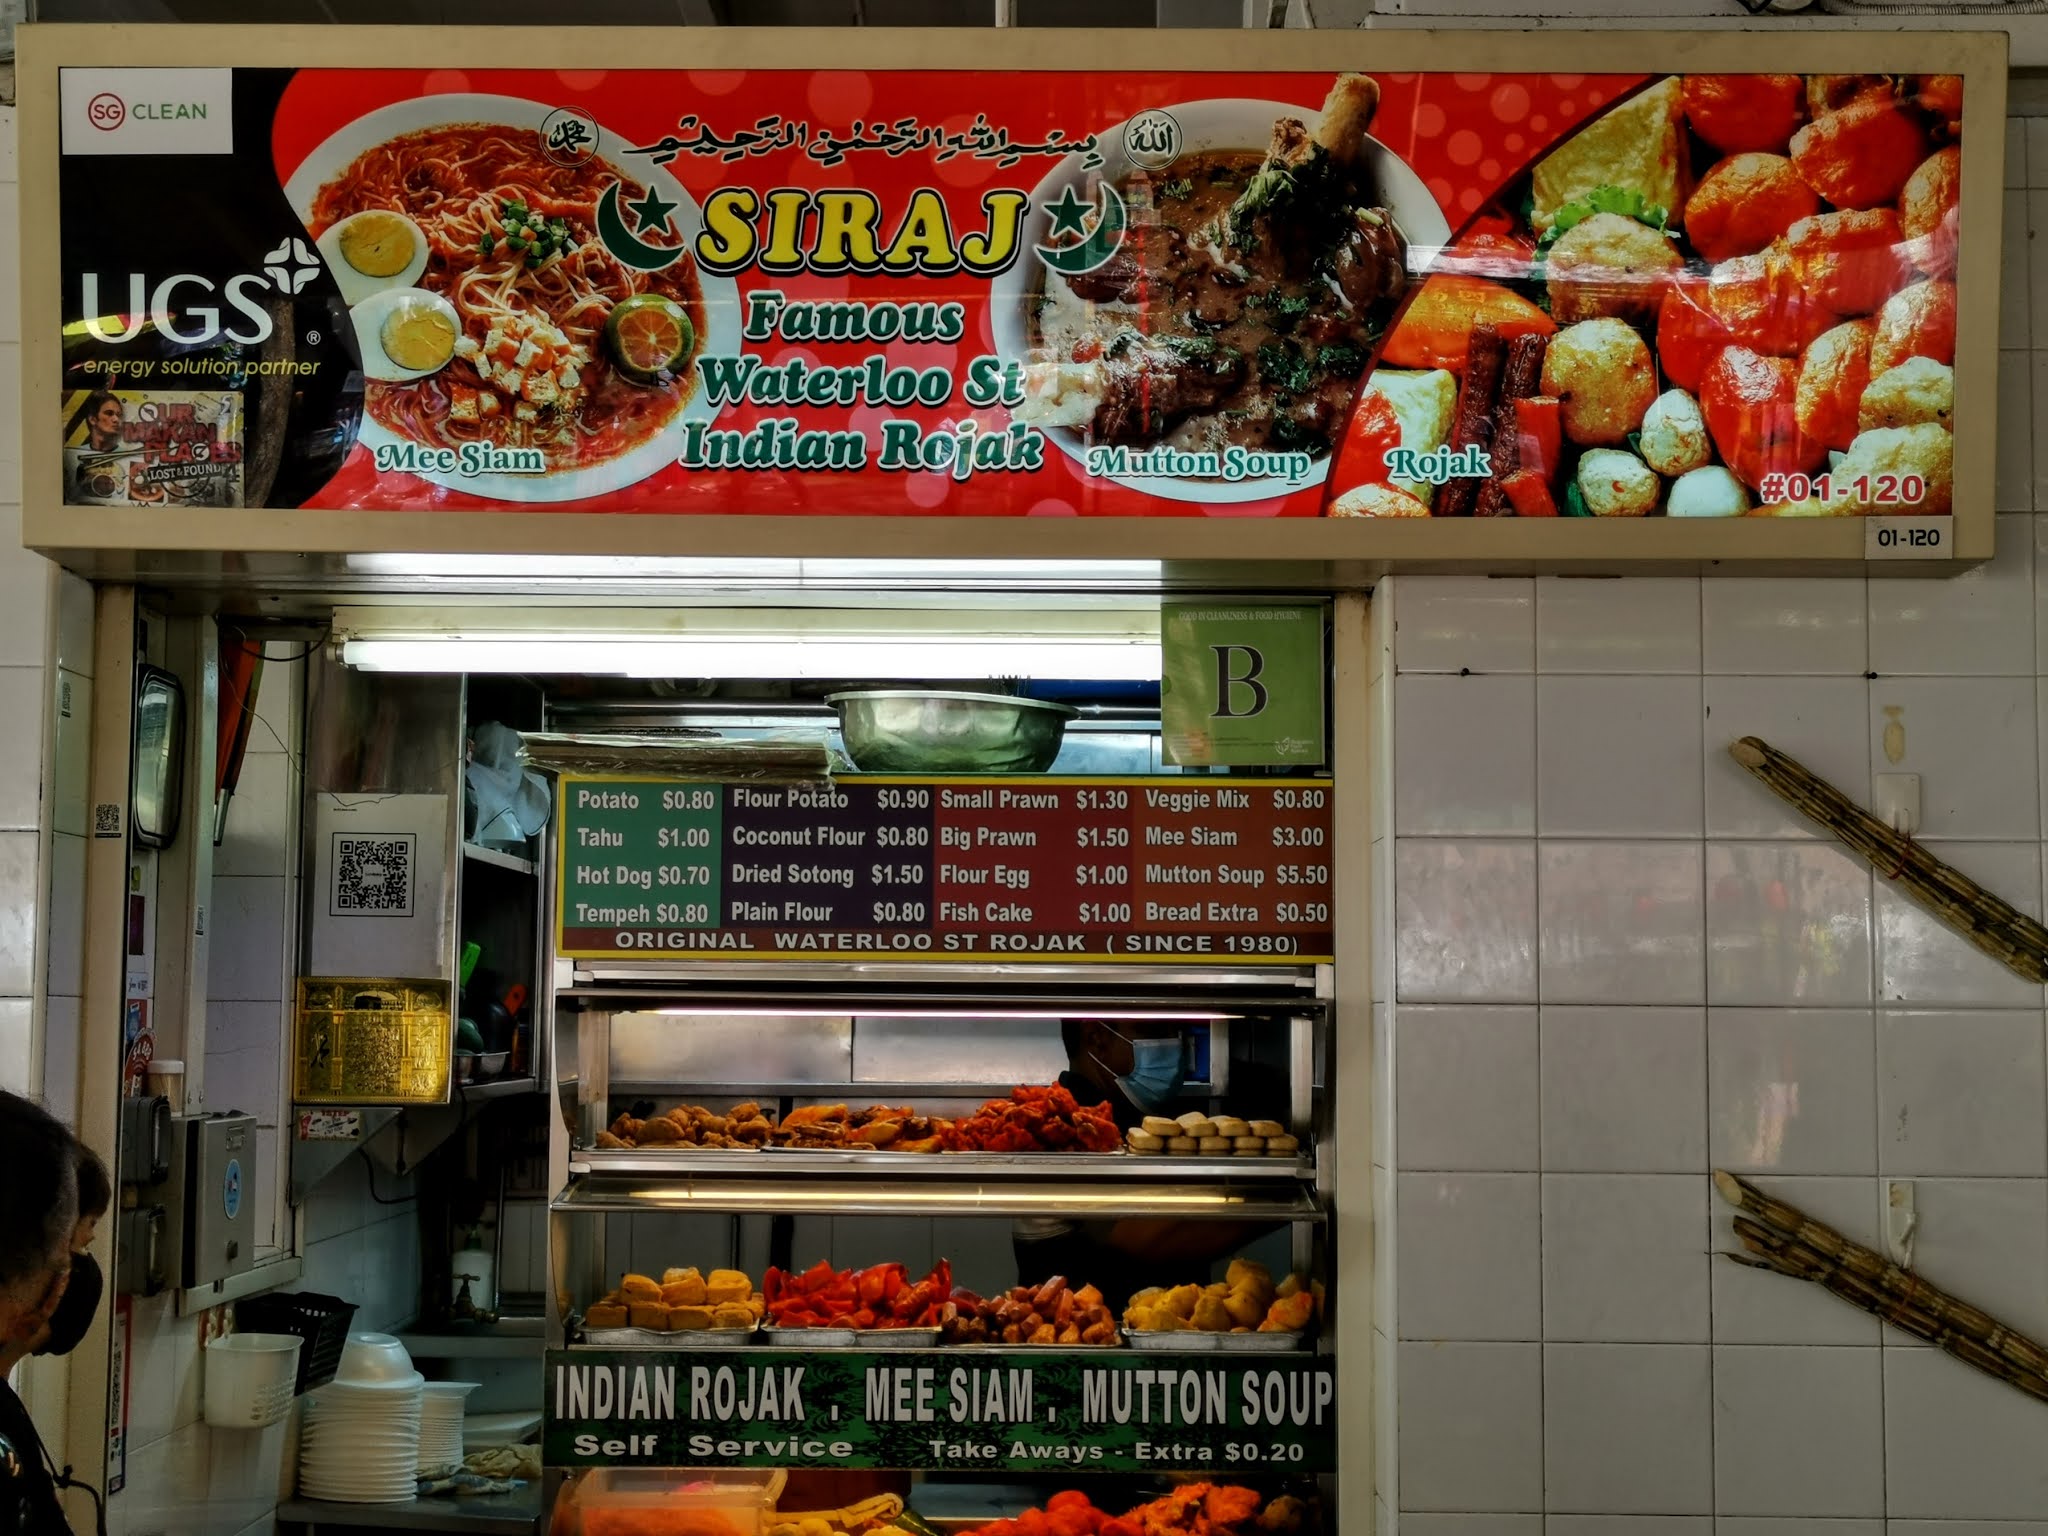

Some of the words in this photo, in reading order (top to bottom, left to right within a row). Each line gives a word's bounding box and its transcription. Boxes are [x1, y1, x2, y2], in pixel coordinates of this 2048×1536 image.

[93, 103, 122, 121] SG
[132, 103, 208, 120] CLEAN
[697, 189, 1029, 271] SIRAJ
[82, 272, 274, 345] UGS
[745, 291, 963, 340] Famous
[84, 359, 155, 379] energy
[161, 358, 239, 376] solution
[244, 360, 321, 381] partner
[698, 357, 951, 406] Waterloo
[964, 356, 1026, 407] St
[121, 421, 217, 443] MAKAN
[376, 443, 454, 470] Mee
[460, 442, 544, 474] Siam
[682, 419, 864, 470] Indian
[879, 419, 1043, 480] Rojak
[150, 467, 176, 481] LOST
[183, 463, 221, 477] FOUND
[1088, 447, 1218, 475] Mutton
[1224, 447, 1309, 481] Soup
[1386, 447, 1490, 482] Rojak
[1760, 474, 1925, 503] #01-120
[1877, 528, 1941, 547] 01-120
[1208, 644, 1269, 718] B
[578, 789, 640, 809] Potato
[662, 790, 715, 811] $0.80
[733, 788, 782, 808] Flour
[787, 789, 849, 808] Potato
[877, 788, 929, 810] $0.90
[940, 789, 993, 809] Small
[999, 789, 1059, 809] Prawn
[1076, 789, 1128, 810] $1.30
[1145, 788, 1211, 813] Veggie
[1216, 789, 1250, 808] Mix
[1272, 788, 1325, 810] $0.80
[577, 827, 623, 847] Tahu
[658, 827, 710, 849] $1.00
[732, 825, 812, 846] Coconut
[817, 826, 866, 846] Flour
[876, 825, 929, 848] $0.80
[940, 826, 971, 851] Big
[977, 826, 1037, 846] Prawn
[1077, 826, 1129, 849] $1.50
[1145, 826, 1185, 846] Mee
[1190, 826, 1238, 846] Siam
[1272, 826, 1324, 848] $3.00
[576, 865, 610, 885] Hot
[616, 865, 652, 890] Dog
[658, 865, 710, 887] $0.70
[732, 863, 782, 883] Dried
[787, 863, 854, 889] Sotong
[871, 863, 924, 886] $1.50
[940, 864, 989, 884] Flour
[994, 864, 1030, 889] Egg
[1076, 864, 1128, 886] $1.00
[1145, 864, 1212, 884] Mutton
[1217, 864, 1265, 889] Soup
[1276, 864, 1328, 885] $5.50
[575, 903, 650, 927] Tempeh
[656, 903, 708, 924] $0.80
[731, 901, 779, 921] Plain
[784, 901, 834, 922] Flour
[872, 901, 925, 924] $0.80
[940, 902, 979, 922] Fish
[985, 902, 1033, 922] Cake
[1079, 902, 1131, 924] $1.00
[1145, 901, 1201, 921] Bread
[1207, 902, 1259, 922] Extra
[1276, 902, 1328, 924] $0.50
[615, 931, 755, 949] ORIGINAL
[774, 932, 932, 950] WATERLOO
[943, 933, 979, 950] ST
[990, 934, 1086, 951] ROJAK
[1125, 934, 1212, 952] SINCE
[1224, 935, 1298, 956] 1980)
[556, 1365, 675, 1420] INDIAN
[690, 1365, 806, 1421] ROJAK
[865, 1367, 935, 1422] MEE
[949, 1367, 1033, 1423] SIAM
[1083, 1369, 1226, 1425] MUTTON
[1241, 1369, 1333, 1426] SOUP
[573, 1434, 659, 1456] Self
[688, 1434, 853, 1458] Service
[928, 1440, 998, 1459] Take
[1009, 1440, 1104, 1464] Aways
[1135, 1441, 1213, 1461] Extra
[1224, 1442, 1304, 1463] $0.20
